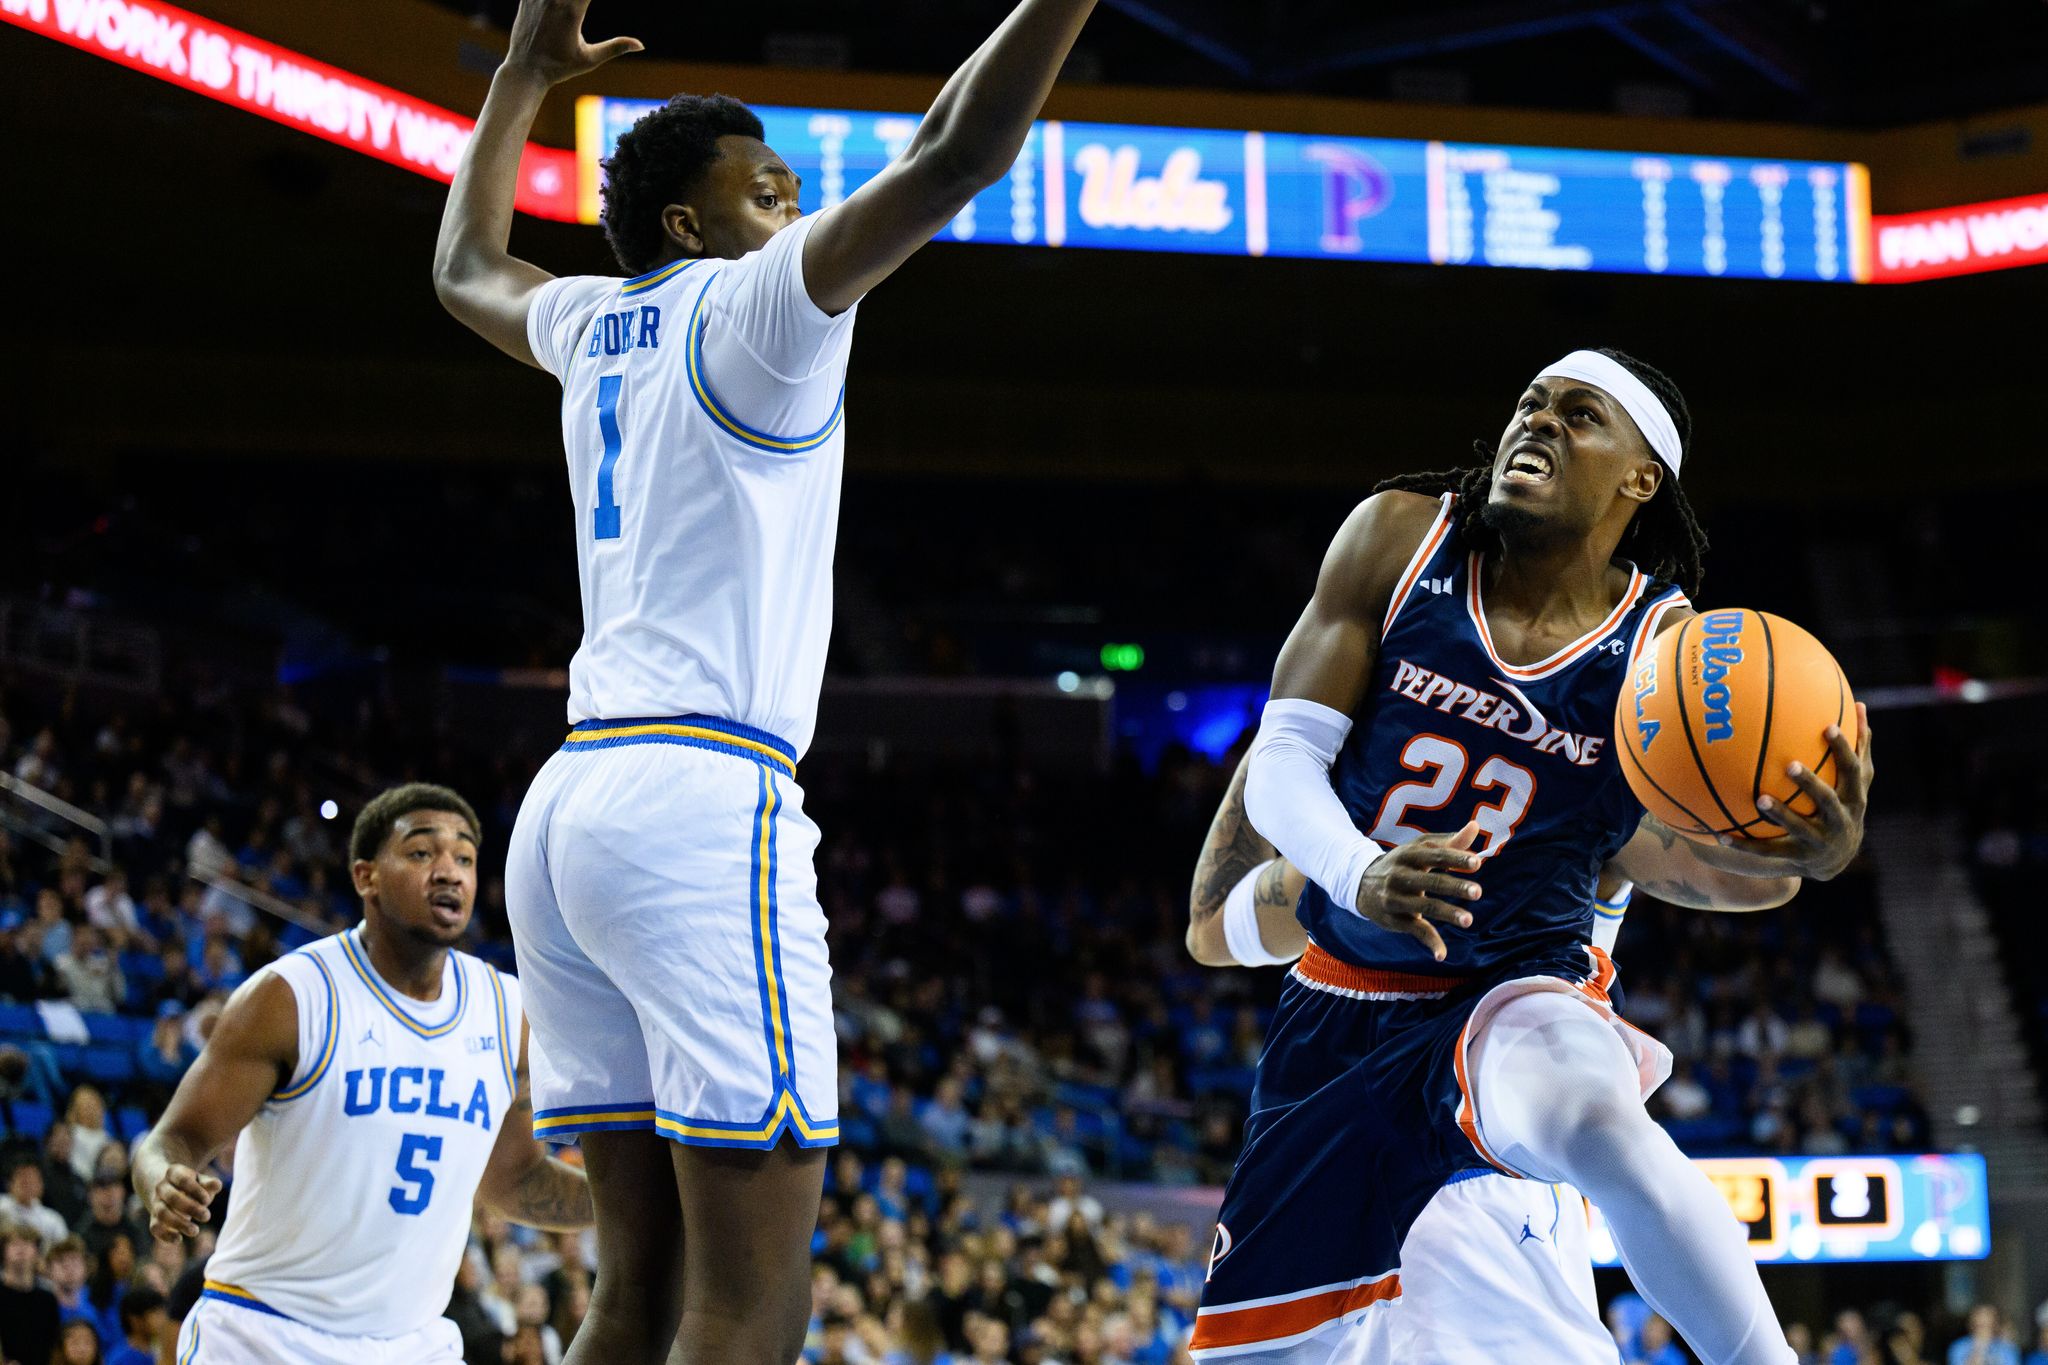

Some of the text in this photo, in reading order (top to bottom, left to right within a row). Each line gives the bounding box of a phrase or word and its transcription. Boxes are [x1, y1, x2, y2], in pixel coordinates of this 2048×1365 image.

[54, 0, 188, 76] WORK
[189, 28, 233, 89] IS
[1304, 142, 1396, 253] P
[1879, 220, 1970, 270] FAN
[1966, 204, 2048, 257] WO
[588, 305, 660, 358] BOKR
[594, 374, 623, 540] 1
[1390, 660, 1604, 766] PEPPERDINE
[1701, 611, 1745, 744] Wilson
[1366, 732, 1537, 873] 23
[344, 1066, 491, 1131] UCLA
[388, 1132, 443, 1215] 5
